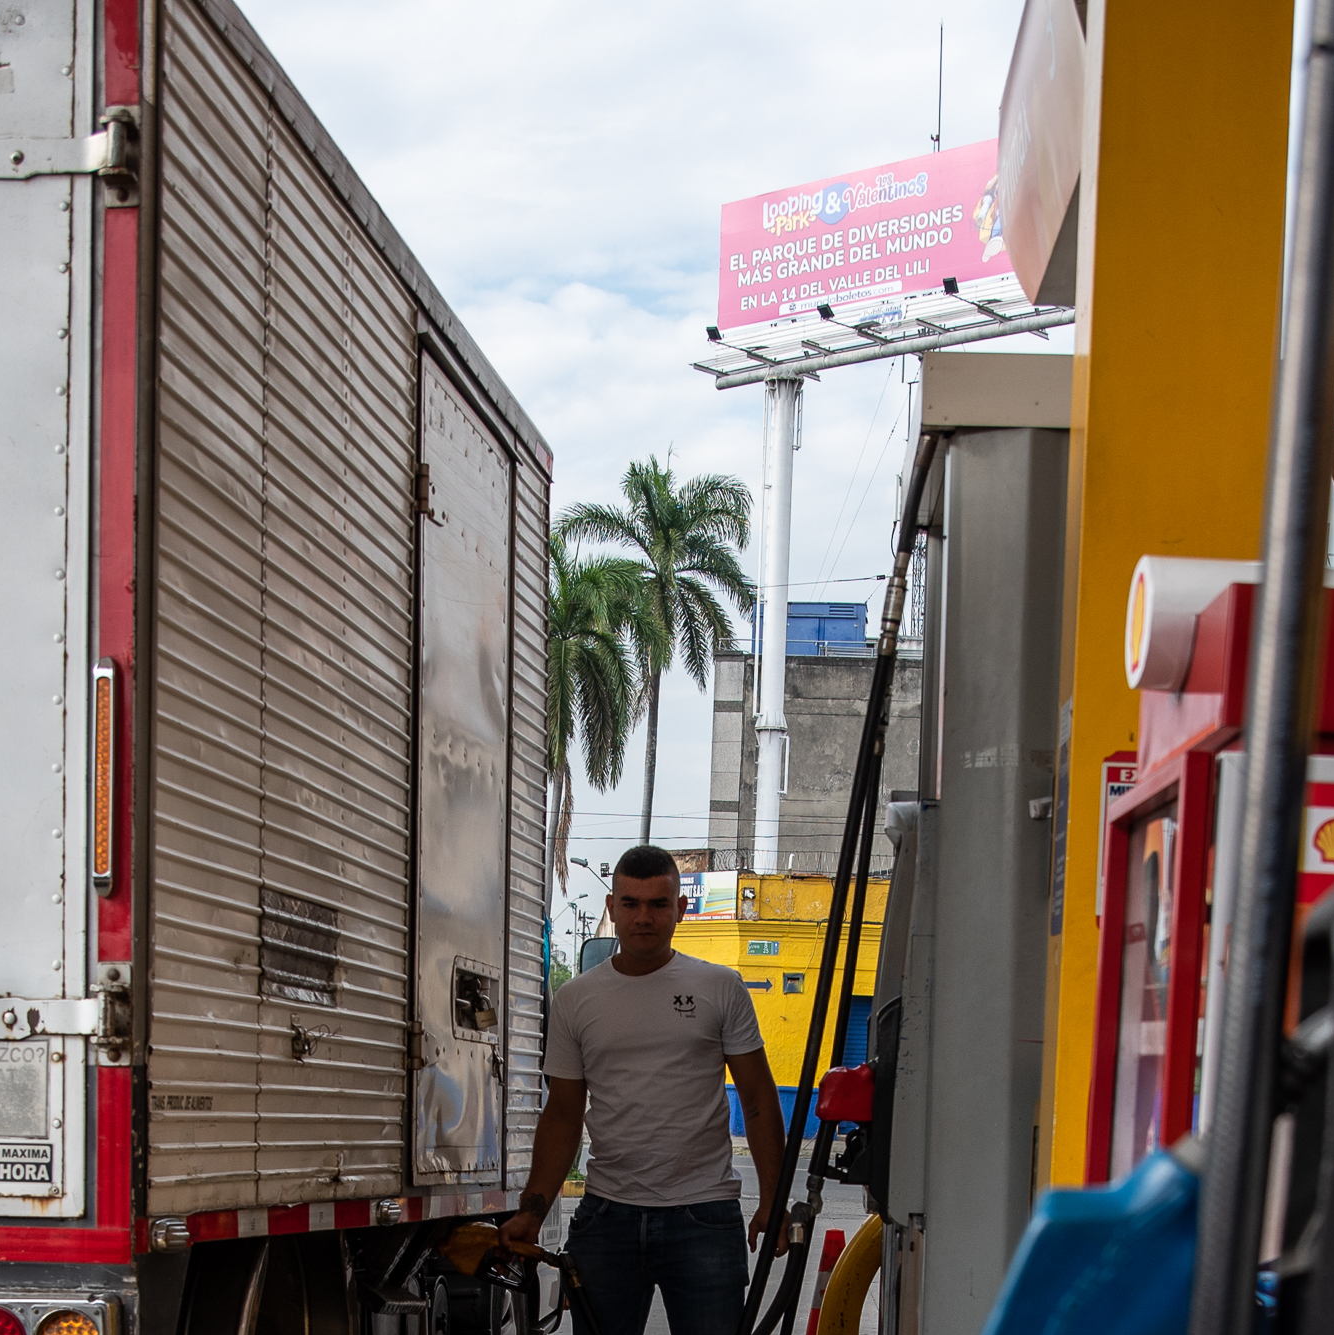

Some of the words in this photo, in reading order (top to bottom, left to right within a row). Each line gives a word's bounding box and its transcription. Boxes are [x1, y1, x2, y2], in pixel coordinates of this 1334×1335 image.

[762, 189, 824, 230] Looping
[824, 190, 842, 215] &
[842, 172, 928, 213] Valentinos
[729, 253, 748, 271] EL
[751, 236, 818, 266] PARQUE
[821, 230, 843, 249] DE
[848, 204, 964, 243] DIVERSIONES
[737, 263, 773, 288] MÁS
[776, 251, 845, 279] GRANDE
[849, 245, 881, 264] DEL
[886, 226, 953, 255] MUNDO
[740, 295, 758, 311] EN
[760, 291, 778, 307] LA
[781, 286, 796, 303] 14
[799, 281, 825, 299] DEL
[828, 270, 871, 292] VALLE
[874, 264, 902, 281] DEL
[905, 258, 930, 277] LILI
[800, 285, 894, 310] mundoboletos.com
[0, 1163, 50, 1181] HORA
[1, 1148, 49, 1159] MAXIMA
